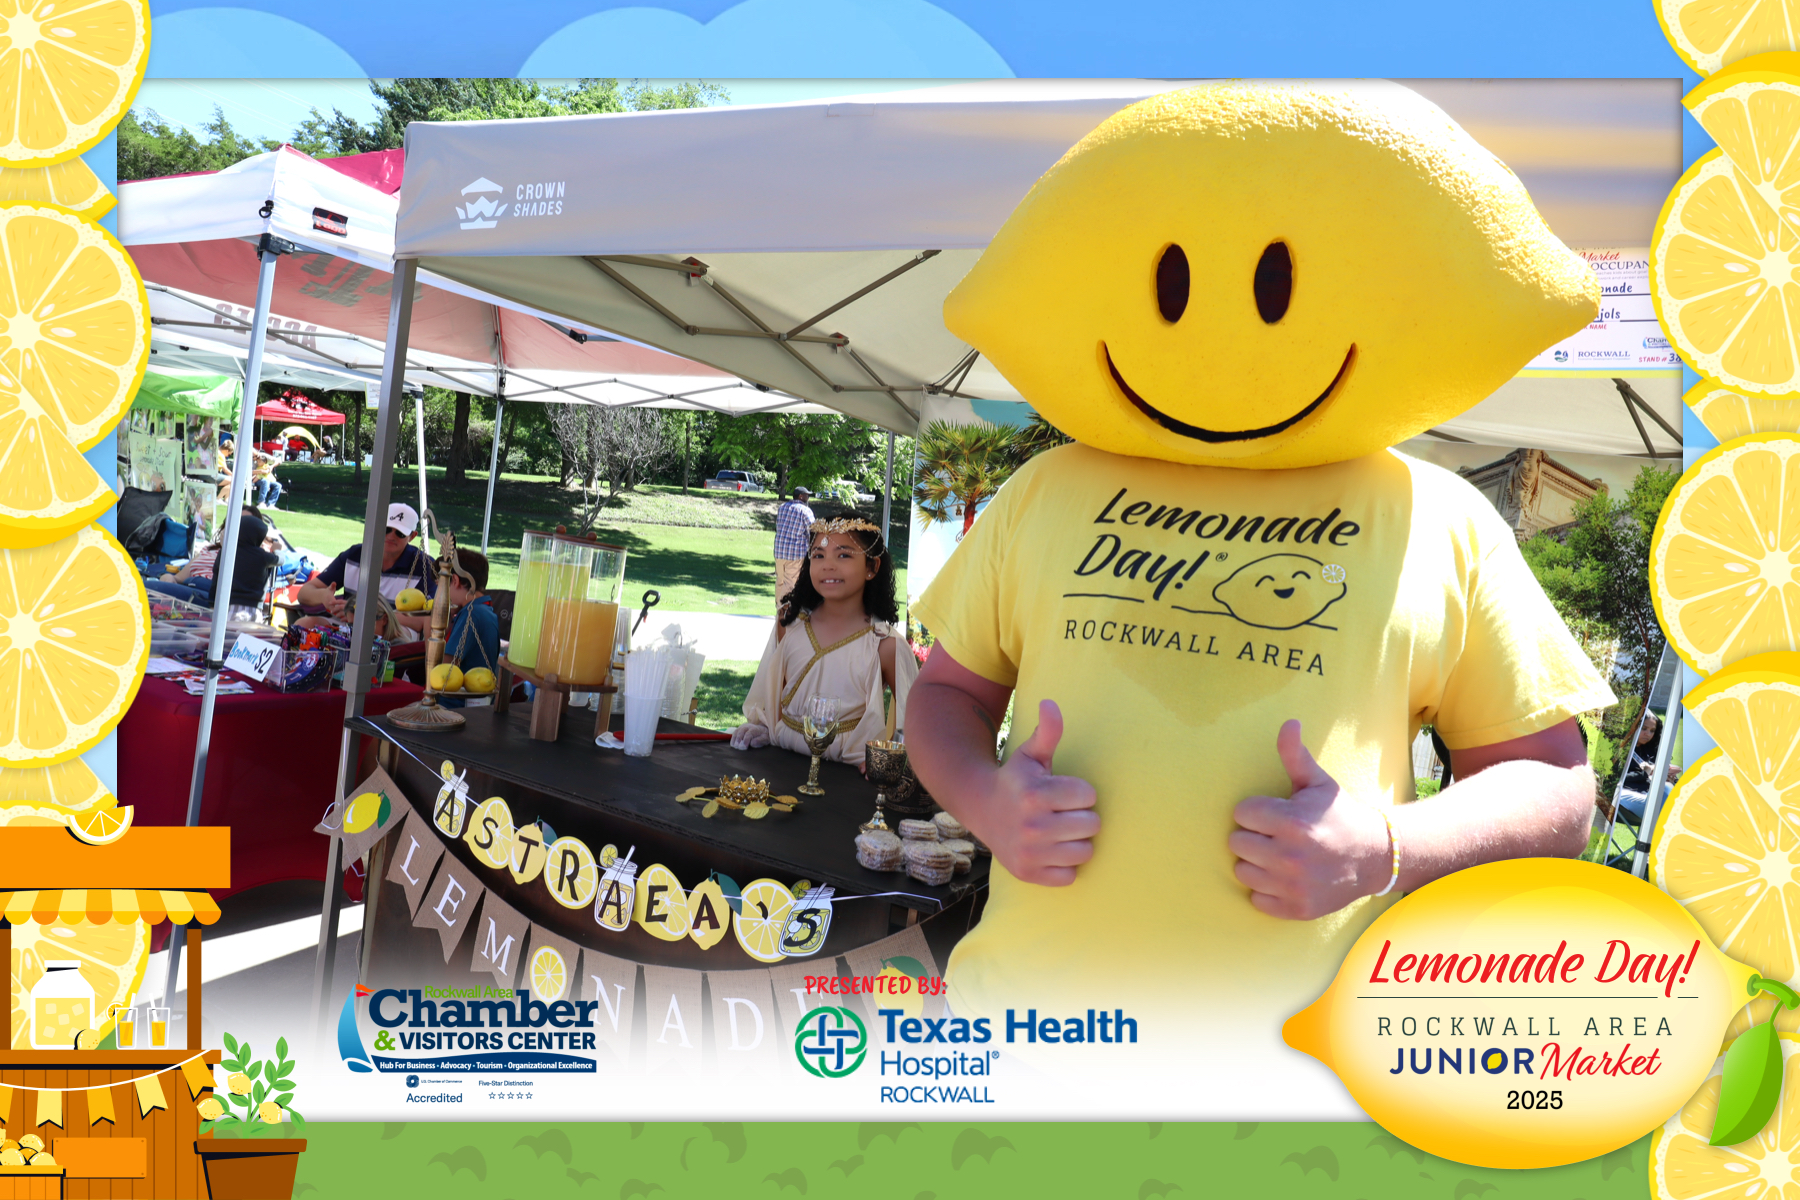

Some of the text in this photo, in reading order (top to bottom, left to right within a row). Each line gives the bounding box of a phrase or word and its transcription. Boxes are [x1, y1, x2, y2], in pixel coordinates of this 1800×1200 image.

[516, 182, 565, 200] CROWN
[513, 201, 563, 217] SHADES
[1579, 250, 1620, 262] Market
[1596, 307, 1621, 321] jols
[1094, 488, 1360, 546] Lemonade
[1064, 620, 1325, 676] ROCKWALL AREA
